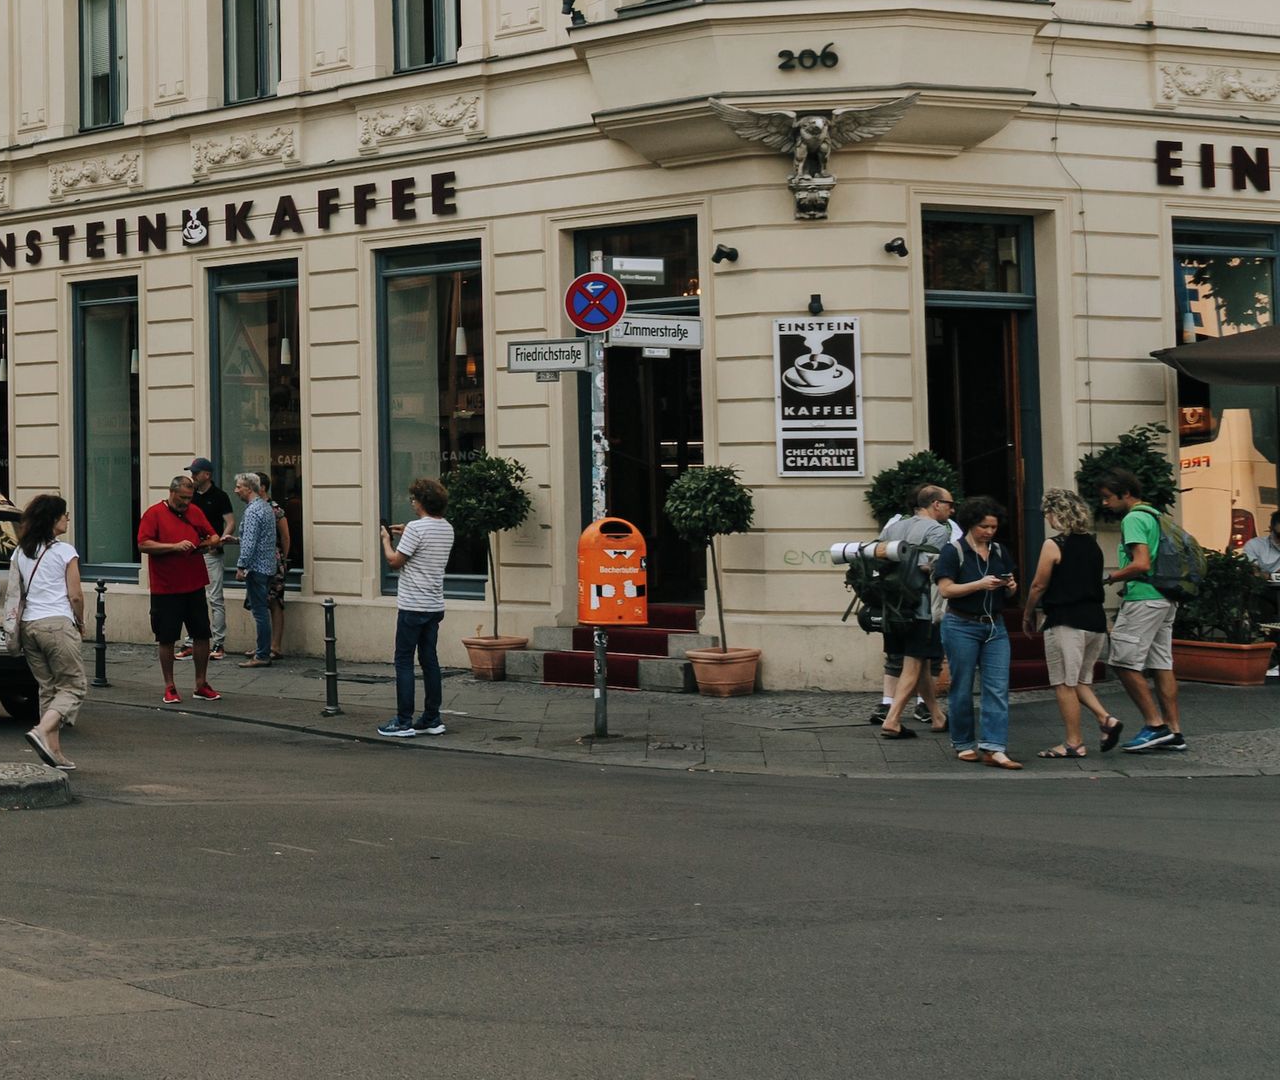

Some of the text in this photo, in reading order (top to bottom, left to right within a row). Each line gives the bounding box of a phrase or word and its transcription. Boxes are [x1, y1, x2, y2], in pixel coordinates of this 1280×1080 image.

[778, 42, 839, 69] 206
[1156, 140, 1270, 192] EIN
[225, 170, 457, 242] KAFFEE
[624, 321, 689, 340] Zimmerstraße
[778, 322, 855, 332] EINSTEIN
[515, 346, 582, 364] Friedrichstraße
[784, 406, 854, 416] KAFFEE
[785, 448, 855, 456] CHECKPOINT
[785, 456, 855, 467] CHARLIE
